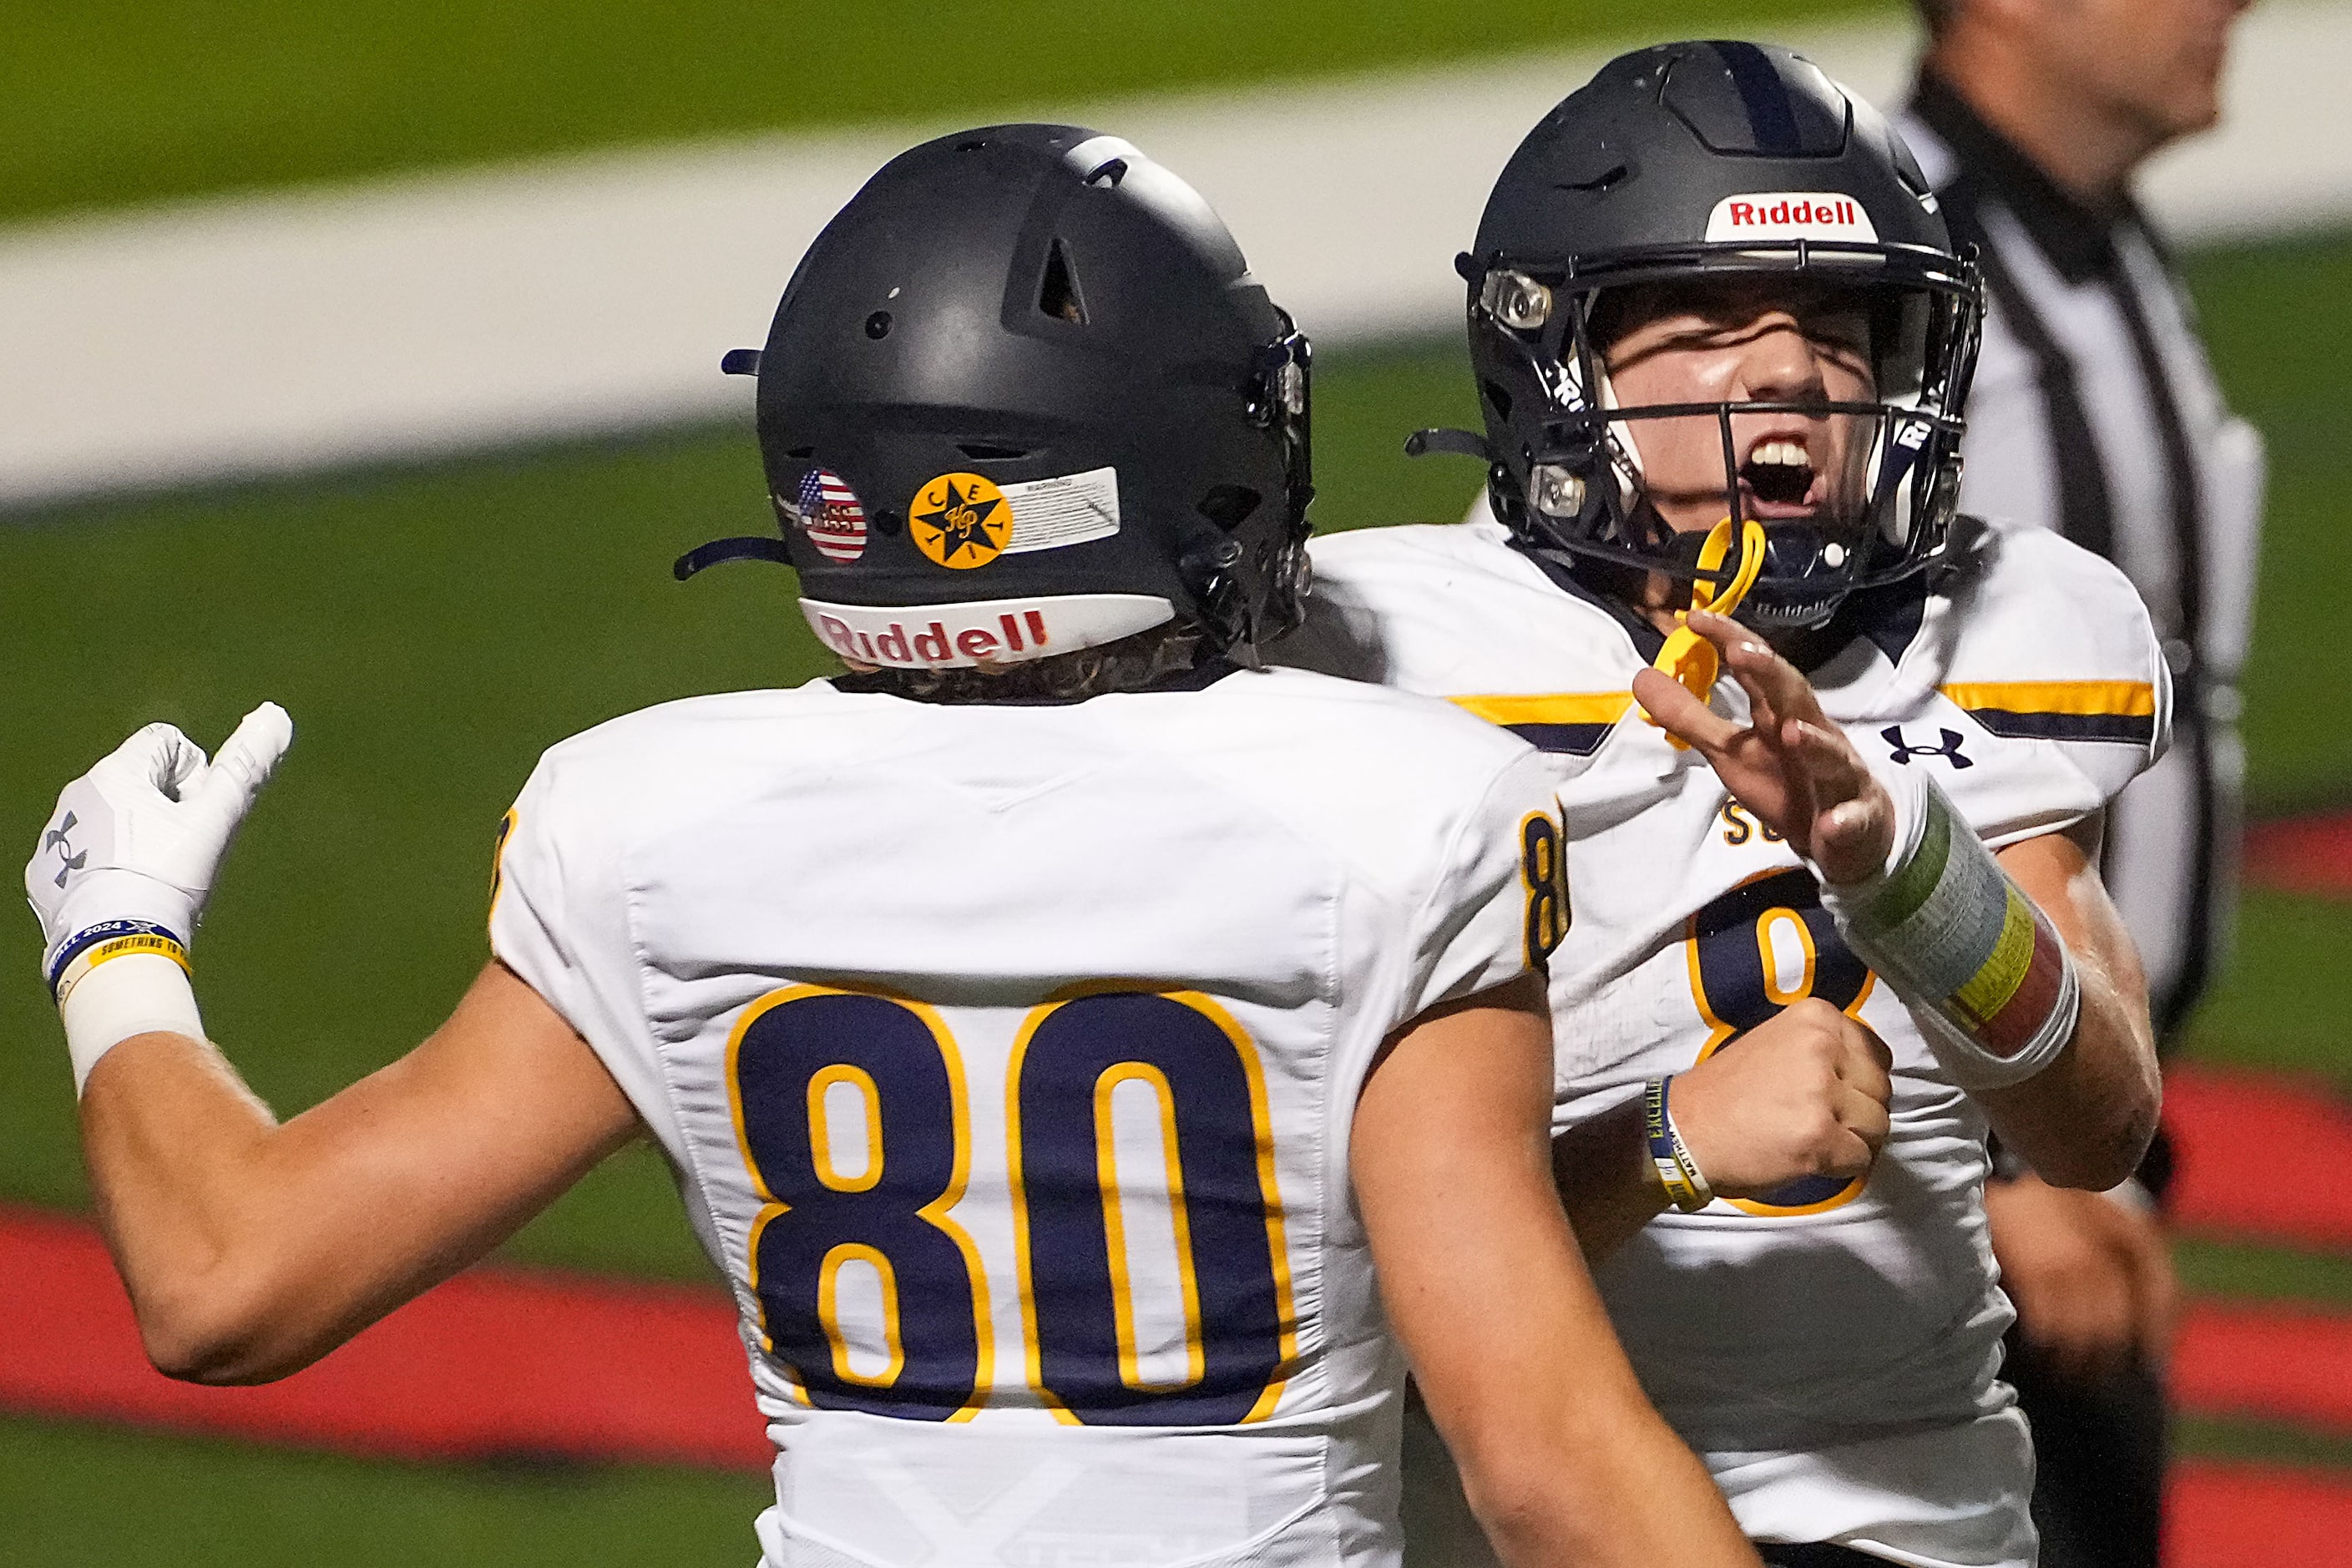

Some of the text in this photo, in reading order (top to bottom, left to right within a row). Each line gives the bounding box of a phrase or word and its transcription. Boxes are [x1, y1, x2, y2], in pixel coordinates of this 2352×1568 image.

[1729, 200, 1855, 225] Riddell
[817, 608, 1047, 662] Riddell
[83, 921, 122, 938] 2024
[101, 936, 163, 957] SOMETHING
[723, 976, 1298, 1426] 80
